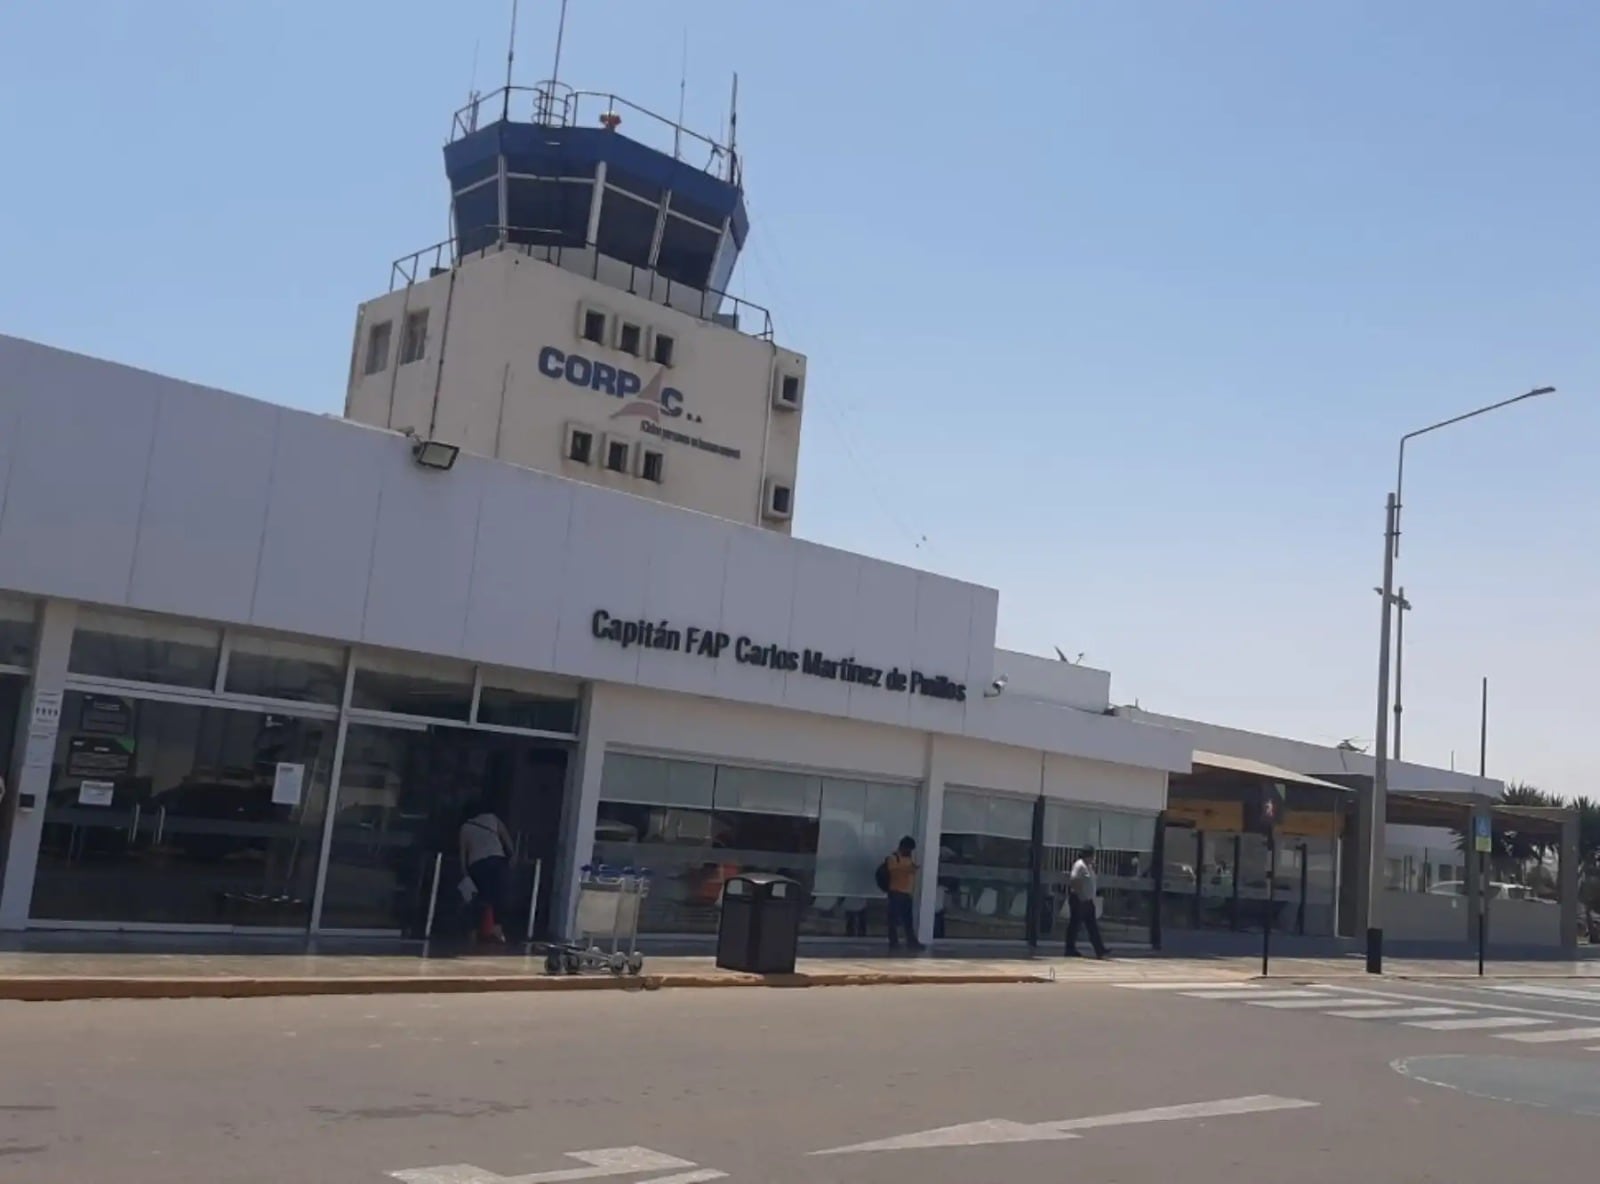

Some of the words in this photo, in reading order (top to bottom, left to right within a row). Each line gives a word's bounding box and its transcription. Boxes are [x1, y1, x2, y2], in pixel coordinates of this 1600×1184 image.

[592, 609, 680, 651] Capitán
[685, 626, 730, 658] FAP
[734, 636, 799, 672] Carlos
[802, 649, 883, 688] Martínez
[885, 667, 907, 692] de
